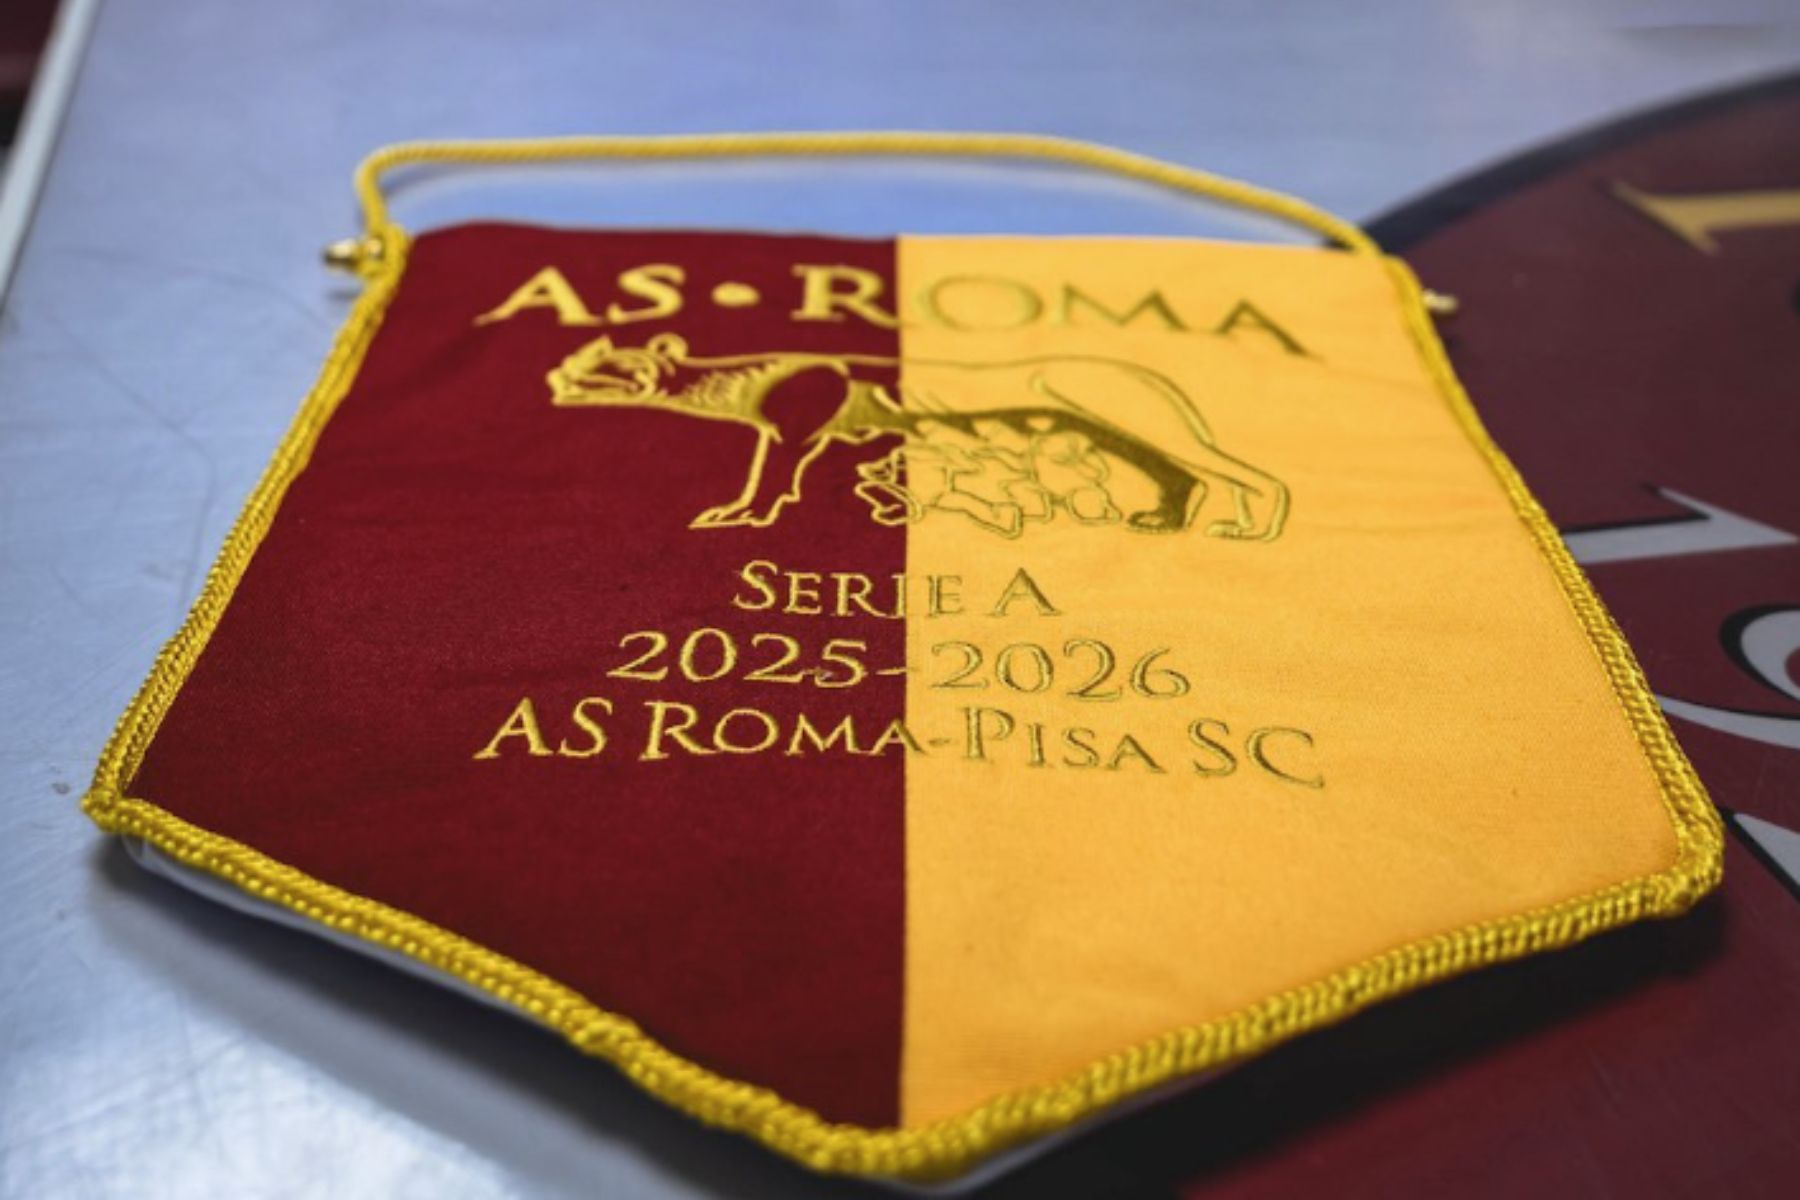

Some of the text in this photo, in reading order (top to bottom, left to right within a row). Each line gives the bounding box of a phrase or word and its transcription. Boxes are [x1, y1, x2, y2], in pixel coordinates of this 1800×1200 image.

[473, 264, 1326, 361] AS ROMA
[991, 567, 1065, 618] A
[605, 628, 1191, 703] 2025-2026
[473, 696, 613, 760] AS
[1190, 718, 1326, 789] SC
